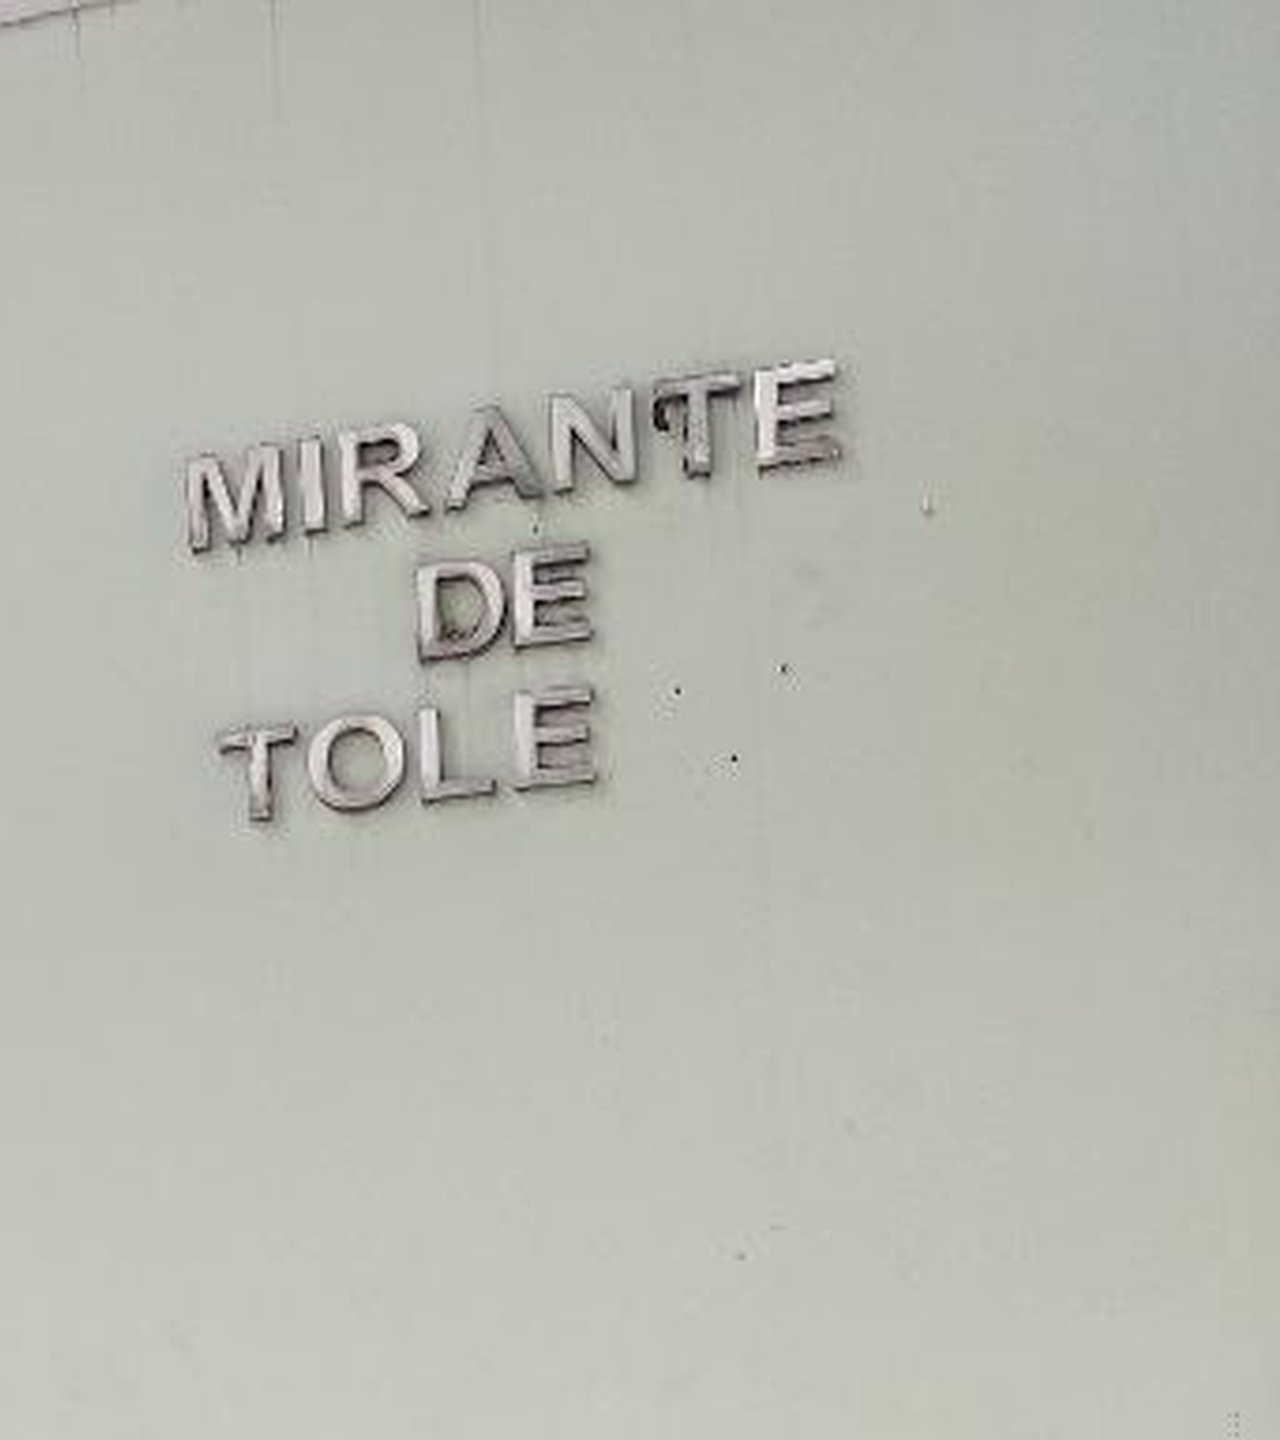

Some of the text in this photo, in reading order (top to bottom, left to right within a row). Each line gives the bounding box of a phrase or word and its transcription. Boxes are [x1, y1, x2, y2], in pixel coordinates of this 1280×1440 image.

[183, 358, 842, 553] MIRANTE
[414, 541, 593, 665] DE
[218, 686, 597, 822] TOLE
